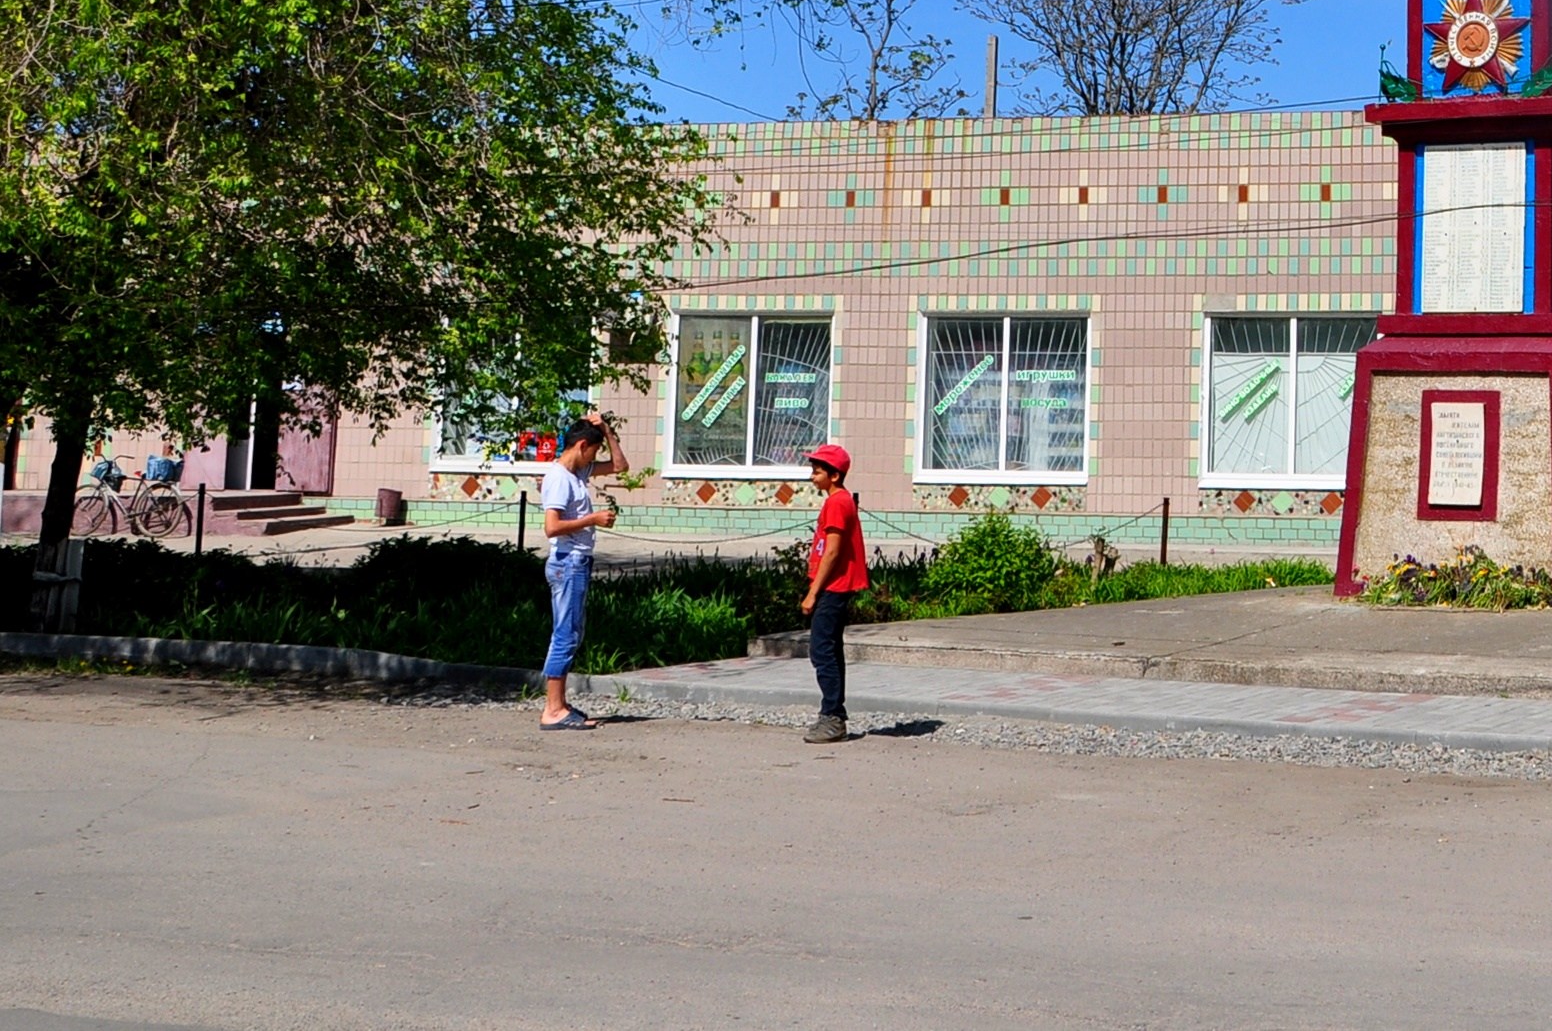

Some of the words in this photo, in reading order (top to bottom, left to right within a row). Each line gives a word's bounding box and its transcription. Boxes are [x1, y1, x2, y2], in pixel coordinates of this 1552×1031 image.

[1016, 370, 1076, 383] игрушки
[934, 355, 994, 415] мороженое
[1021, 398, 1067, 409] посуда
